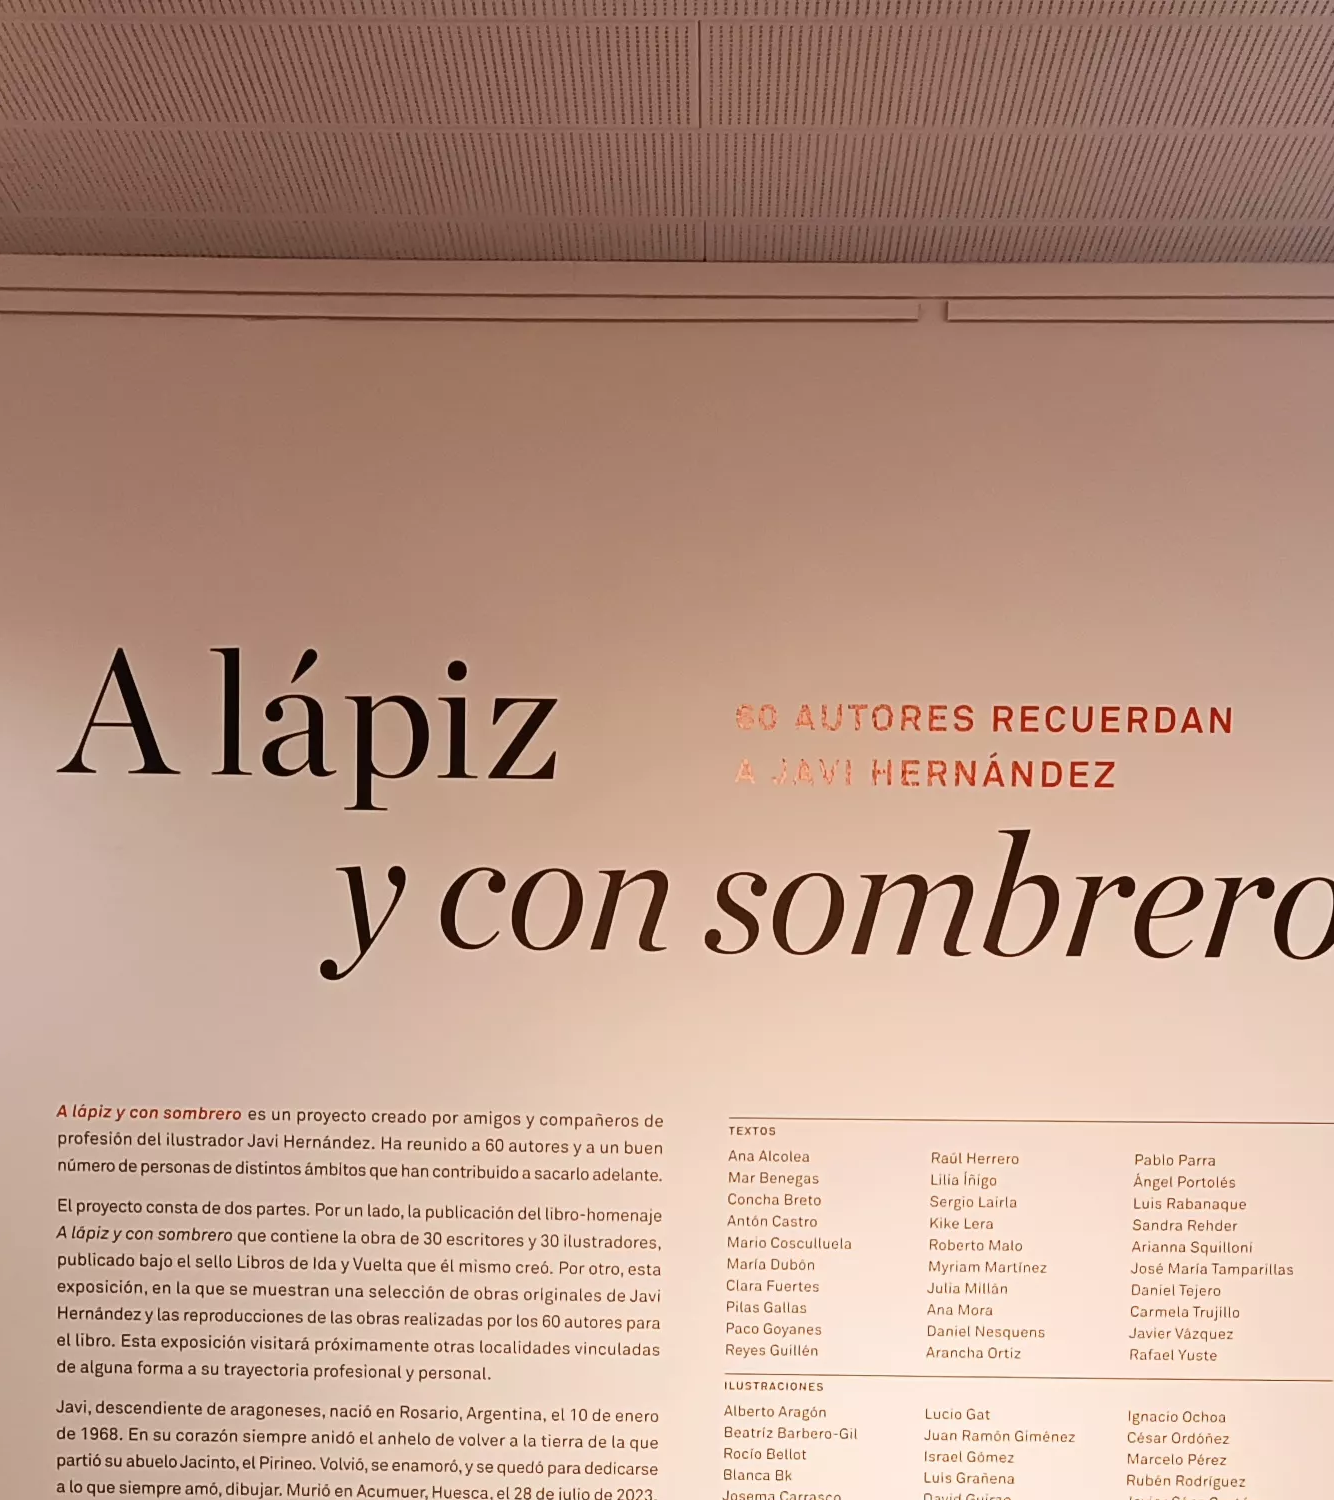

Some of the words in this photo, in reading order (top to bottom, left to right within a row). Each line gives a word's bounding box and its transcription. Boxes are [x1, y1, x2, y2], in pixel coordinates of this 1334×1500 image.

[793, 703, 975, 732] AUTORES
[991, 704, 1233, 734] RECUERDAN
[58, 649, 181, 775] A
[211, 649, 558, 811] lápiz
[870, 752, 1116, 788] HERNÁNDEZ
[321, 867, 407, 981] y
[442, 868, 669, 952] con
[728, 1126, 776, 1137] TEXTOS
[136, 1131, 162, 1147] del
[166, 1131, 245, 1148] ilustrador
[247, 1133, 279, 1148] Javi
[381, 1135, 403, 1151] Ha
[407, 1136, 468, 1152] reunido
[471, 1141, 481, 1152] a
[485, 1138, 504, 1153] 60
[508, 1140, 569, 1154] autores
[572, 1143, 582, 1158] y
[585, 1143, 595, 1154] a
[600, 1143, 619, 1155] un
[624, 1140, 663, 1155] buen
[727, 1149, 755, 1163] Ana
[758, 1149, 810, 1163] Alcolea
[966, 1152, 1020, 1165] Herrero
[1134, 1153, 1175, 1167] Pablo
[1178, 1153, 1216, 1167] Parra
[727, 1236, 767, 1249] Mario
[770, 1236, 852, 1250] Cosculluela
[929, 1238, 985, 1252] Roberto
[988, 1239, 1023, 1252] Malo
[1131, 1240, 1186, 1254] Arianna
[1190, 1240, 1253, 1257] Squilloni
[726, 1278, 763, 1292] Clara
[766, 1279, 820, 1293] Fuertes
[926, 1281, 961, 1295] Julia
[1131, 1283, 1176, 1297] Daniel
[1178, 1283, 1222, 1300] Tejero
[725, 1343, 766, 1359] Reyes
[925, 1346, 984, 1359] Arancha
[987, 1346, 1022, 1360] Ortiz
[56, 1359, 76, 1374] de
[79, 1359, 133, 1378] alguna
[137, 1360, 184, 1376] forma
[187, 1364, 197, 1376] a
[200, 1364, 219, 1376] su
[224, 1362, 310, 1380] trayectoria
[313, 1363, 402, 1381] profesional
[405, 1368, 415, 1383] y
[418, 1366, 492, 1383] personal.
[724, 1380, 824, 1392] ILUSTRACIONES
[55, 1399, 92, 1416] Javi,
[95, 1400, 203, 1416] descendiente
[206, 1401, 226, 1416] de
[230, 1405, 326, 1421] aragoneses,
[375, 1407, 395, 1419] en
[399, 1404, 463, 1422] Rosario,
[466, 1406, 547, 1425] Argentina,
[551, 1407, 565, 1422] el
[570, 1408, 588, 1422] 10
[592, 1408, 611, 1423] de
[615, 1411, 659, 1423] enero
[723, 1404, 775, 1418] Alberto
[925, 1407, 963, 1421] Lucio
[966, 1407, 991, 1421] Gat
[1128, 1409, 1179, 1426] Ignacio
[1182, 1410, 1226, 1424] Ochoa
